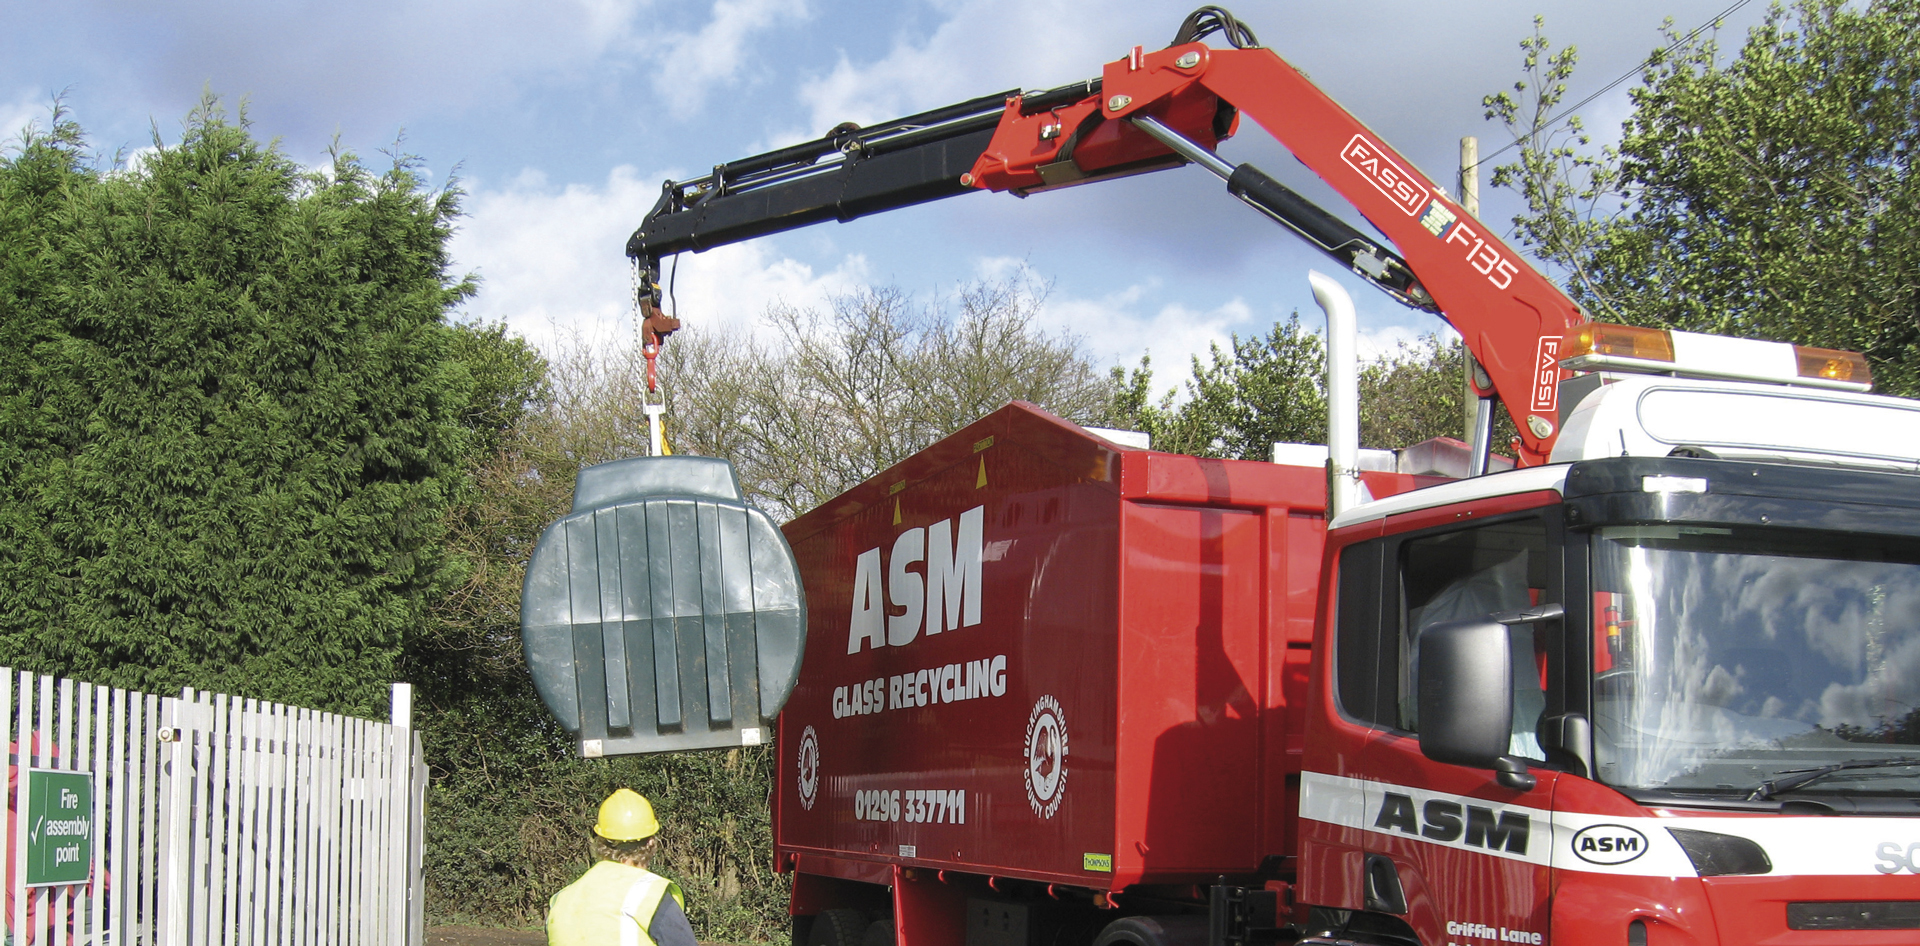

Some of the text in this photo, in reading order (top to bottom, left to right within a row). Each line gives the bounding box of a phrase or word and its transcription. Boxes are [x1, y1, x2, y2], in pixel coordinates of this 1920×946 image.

[1350, 143, 1421, 207] FASSI
[1445, 222, 1519, 290] F135
[1537, 341, 1557, 407] FASSI
[847, 504, 984, 655] ASM
[832, 655, 1007, 719] GLASS RECYCLING
[1023, 694, 1069, 757] BUCKINGHAMSHIRE
[61, 788, 78, 809] Fire
[855, 789, 900, 822] 01296
[905, 789, 965, 825] 337711
[1023, 768, 1068, 820] COUNTY COUNCIL
[46, 815, 90, 840] assembly
[1374, 791, 1530, 856] ASM
[1581, 837, 1638, 852] ASM
[56, 842, 79, 867] point
[1446, 920, 1542, 945] Griffin Lane
